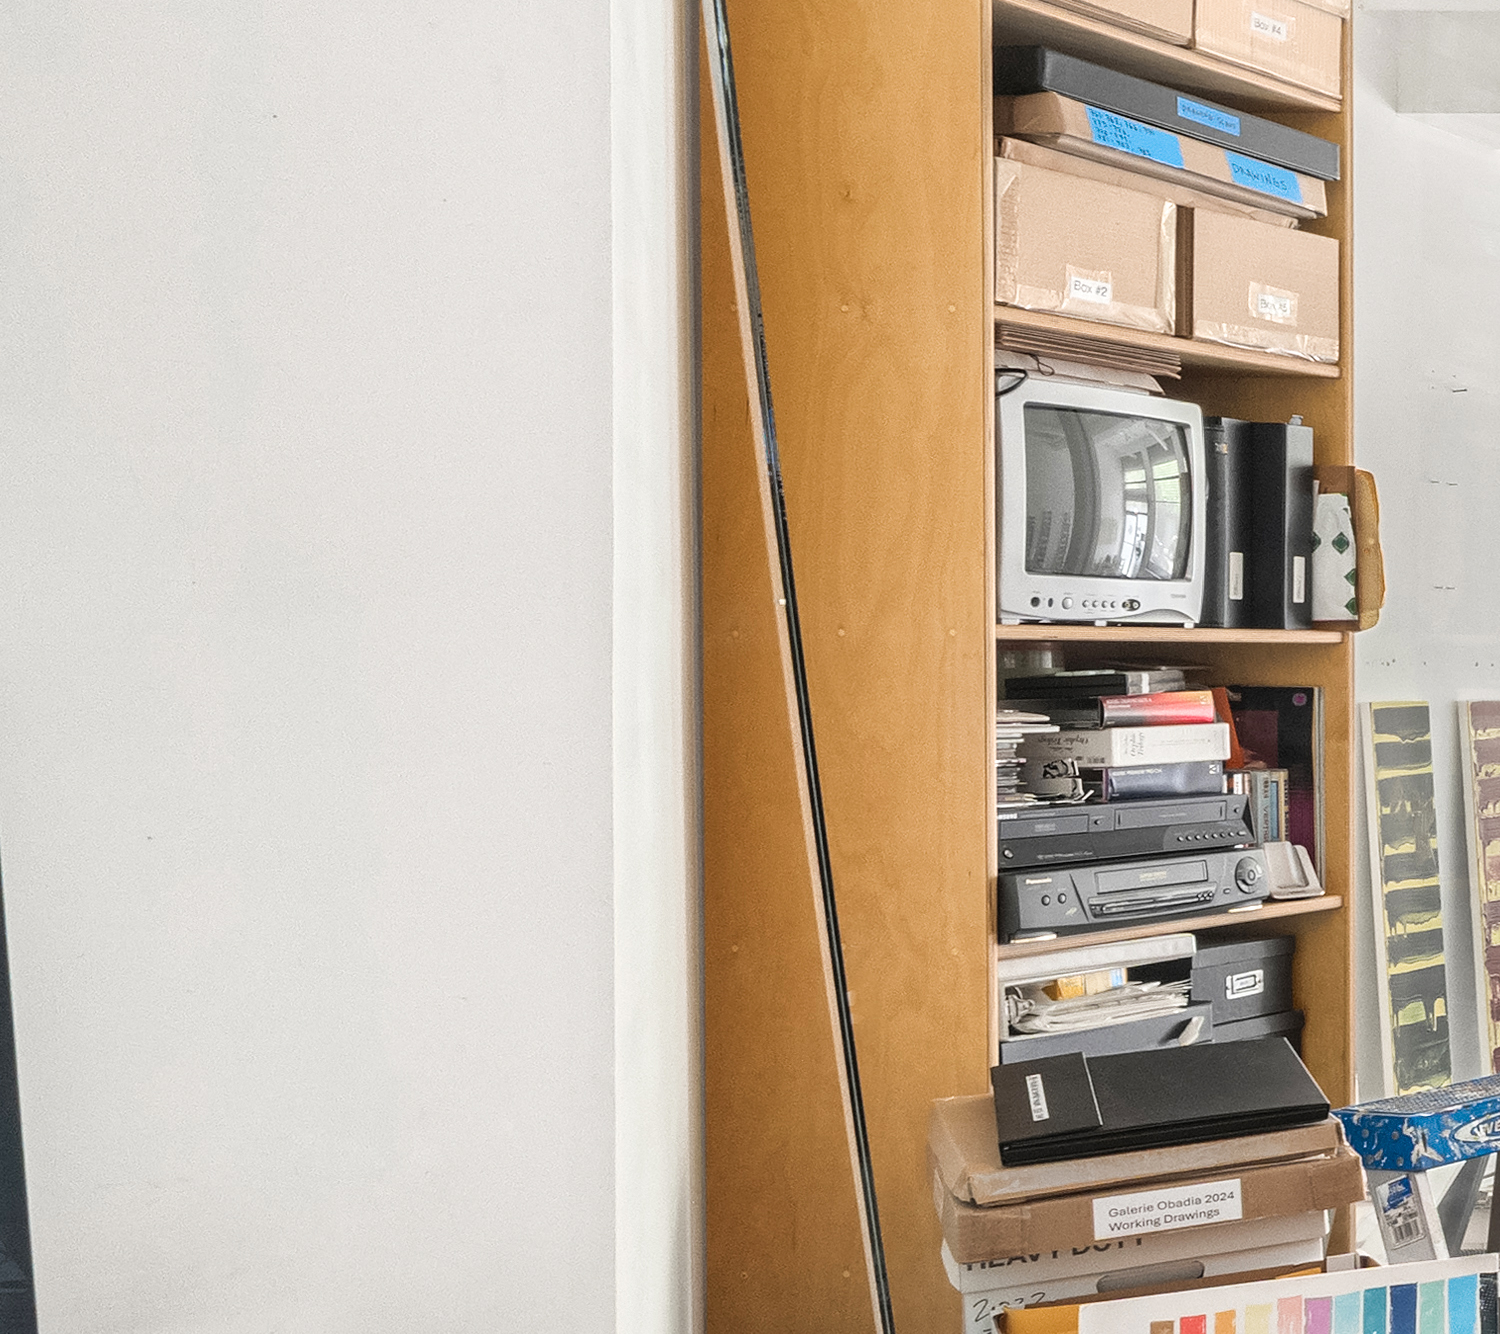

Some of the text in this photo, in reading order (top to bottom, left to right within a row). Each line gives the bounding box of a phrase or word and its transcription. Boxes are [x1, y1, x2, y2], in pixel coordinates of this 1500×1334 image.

[1073, 280, 1109, 298] Box #2
[1108, 1191, 1236, 1220] Galerie Obadia 2024
[1109, 1207, 1222, 1235] Working Drawings
